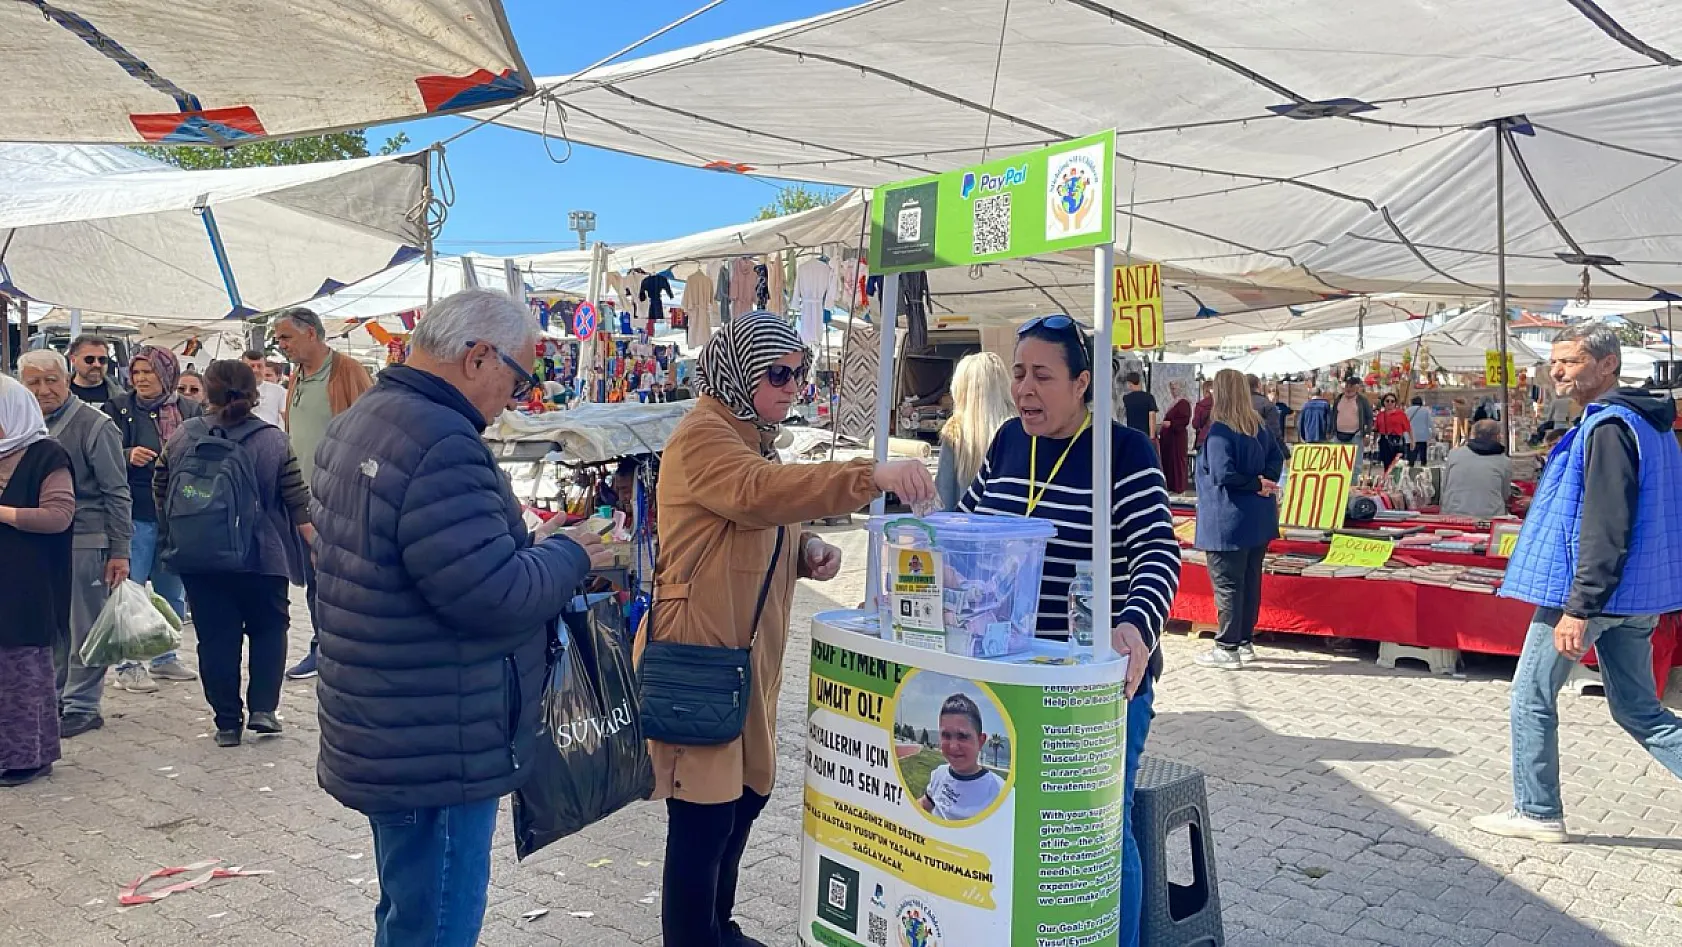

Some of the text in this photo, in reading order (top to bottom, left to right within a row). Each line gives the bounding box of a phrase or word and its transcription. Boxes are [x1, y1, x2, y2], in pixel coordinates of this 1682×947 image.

[980, 165, 1027, 192] PayPal
[1112, 264, 1161, 303] ANTA
[1111, 304, 1157, 350] 50
[1285, 472, 1346, 529] 100
[816, 677, 884, 723] UMUT OL!
[1043, 697, 1067, 708] Help
[1043, 725, 1071, 734] Yusuf
[1074, 724, 1103, 735] Eymen
[1042, 739, 1080, 750] fighting
[1042, 754, 1088, 763] Muscular
[1060, 768, 1080, 777] rare
[813, 755, 836, 781] ADIM
[839, 765, 855, 788] DA
[858, 772, 880, 797] SEN
[883, 781, 903, 806] AT!
[1042, 780, 1096, 791] threatening
[1040, 810, 1064, 820] With
[1065, 811, 1087, 821] your
[833, 800, 926, 846] YAPACAĞINIZ HER DESTEK
[1040, 826, 1062, 835] give
[1064, 823, 1082, 832] him
[1040, 839, 1052, 848] at
[1053, 839, 1070, 848] life
[1079, 837, 1093, 846] the
[1040, 854, 1060, 863] The
[1062, 847, 1106, 862] treatment
[888, 840, 922, 864] YAŞAMA
[924, 855, 993, 883] TUTUNMASINI
[1040, 867, 1069, 877] needs
[1072, 866, 1080, 875] is
[1039, 880, 1088, 892] expensive
[1039, 897, 1055, 905] we
[1057, 896, 1074, 905] can
[1076, 891, 1099, 902] make
[1038, 924, 1057, 933] Our
[1038, 937, 1066, 947] Yusuf
